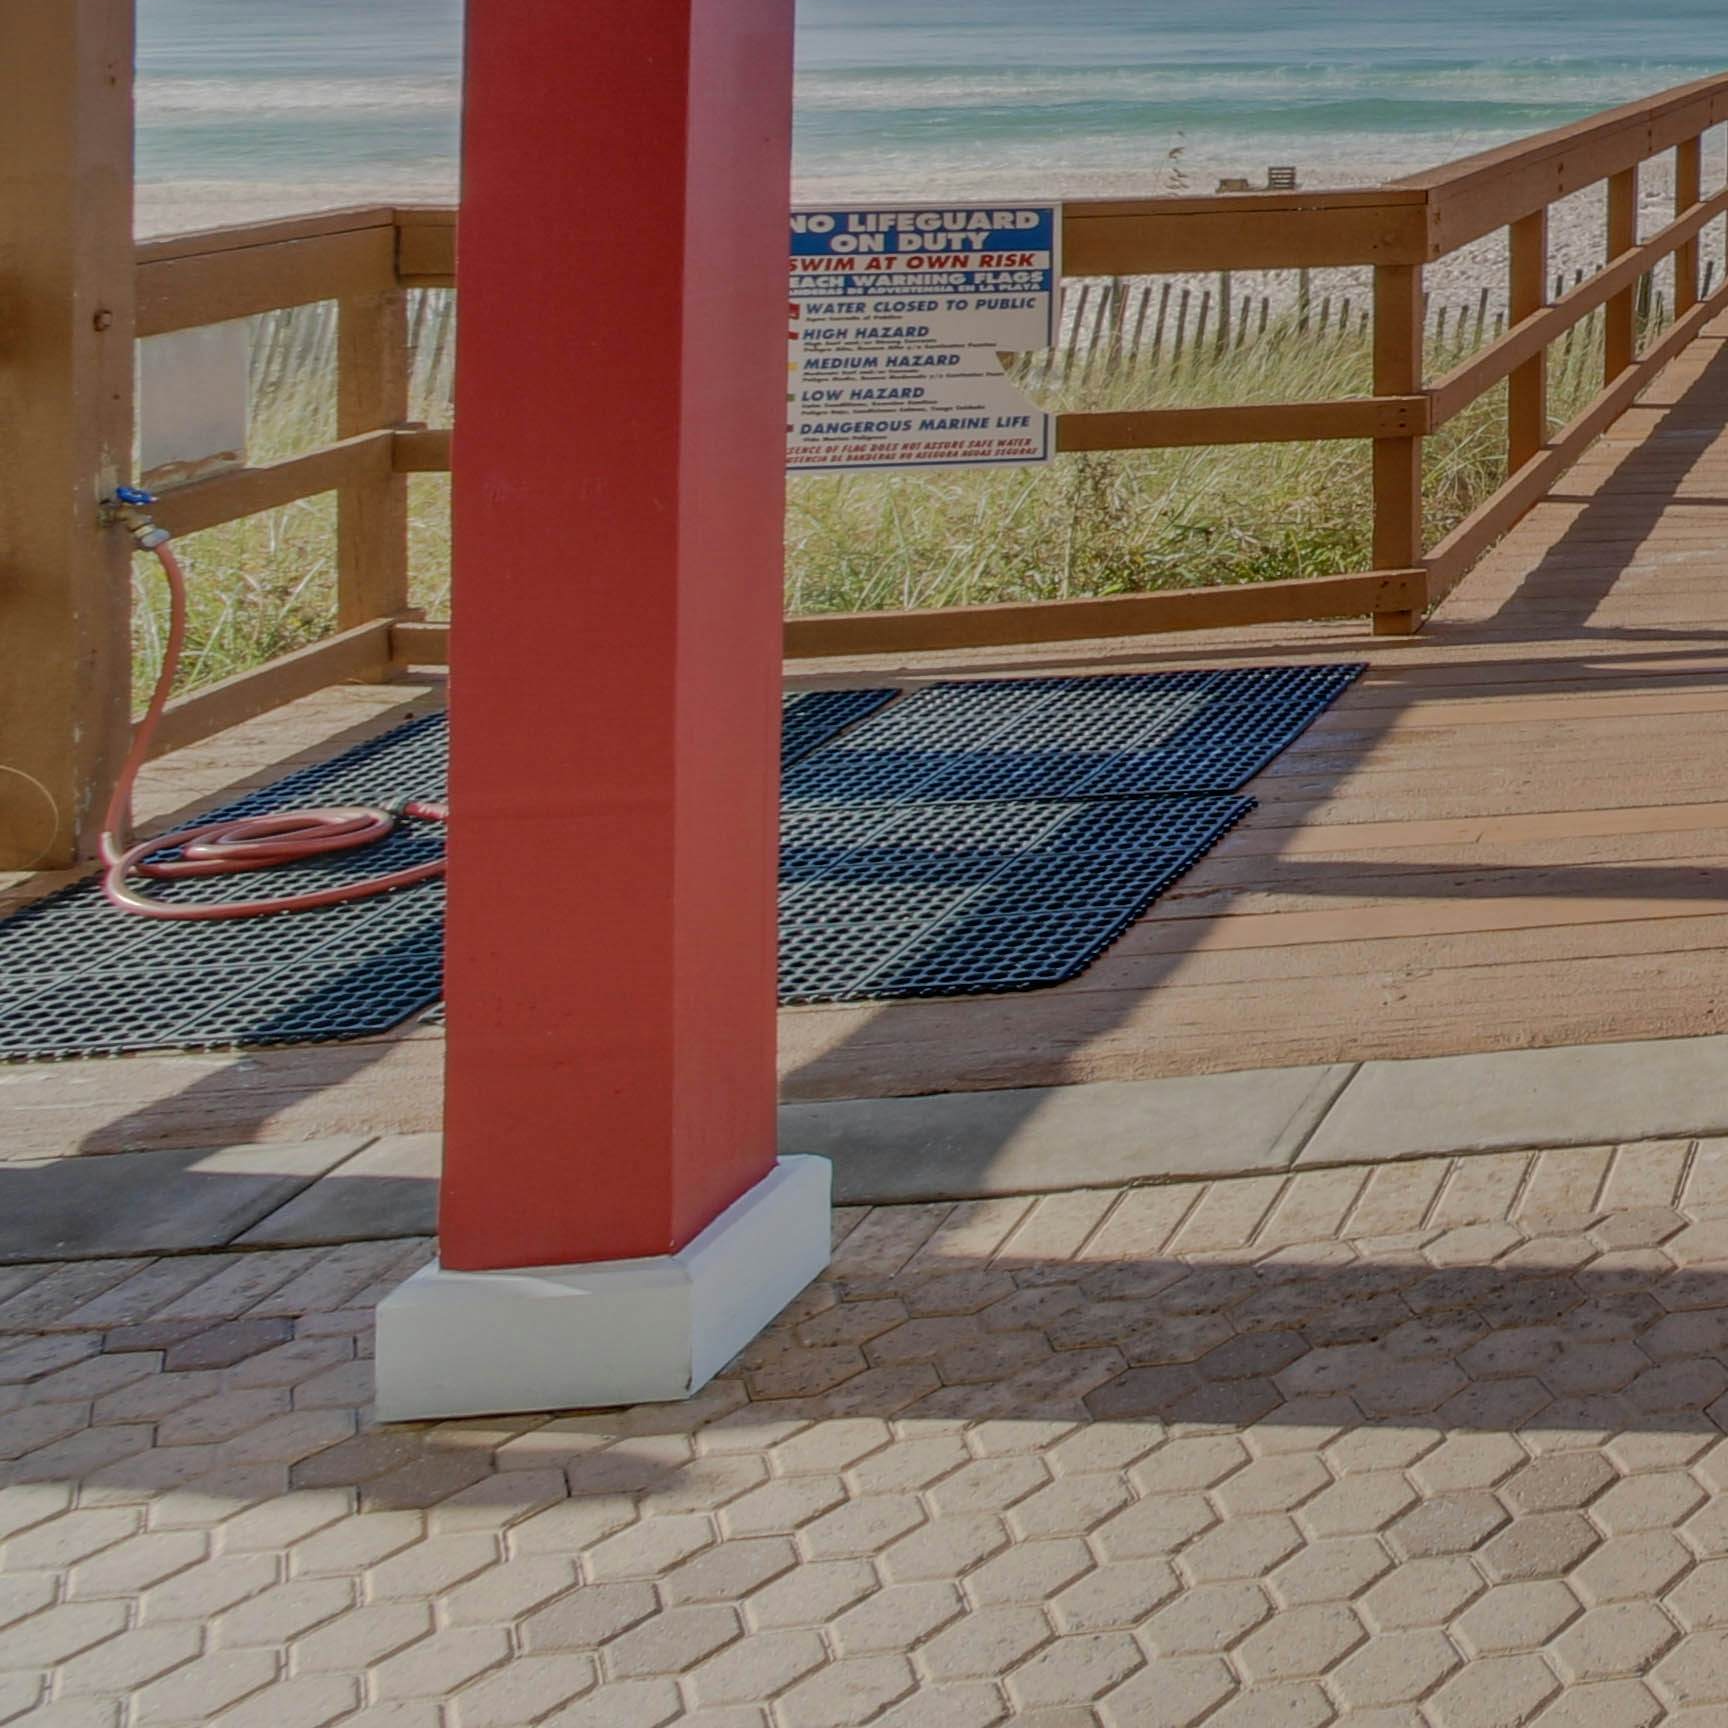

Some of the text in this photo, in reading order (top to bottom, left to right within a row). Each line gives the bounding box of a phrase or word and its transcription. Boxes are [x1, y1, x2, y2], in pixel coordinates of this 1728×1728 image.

[848, 211, 1040, 232] LIFEGUARD
[830, 232, 990, 252] ON DUTY
[864, 257, 897, 270] AT
[905, 255, 969, 269] OWN
[978, 253, 1035, 268] RISK
[789, 272, 1044, 288] EACH WARNING FLAGS
[806, 297, 1037, 314] WATER CLOSED TO PUBLIC
[803, 326, 929, 340] HIGH HAZARD
[803, 354, 961, 370] MEDIUM HAZARD
[801, 387, 925, 402] LOW HAZARD
[800, 415, 1031, 435] DANGEROUS MARINE LIFE
[997, 438, 1033, 448] WATER
